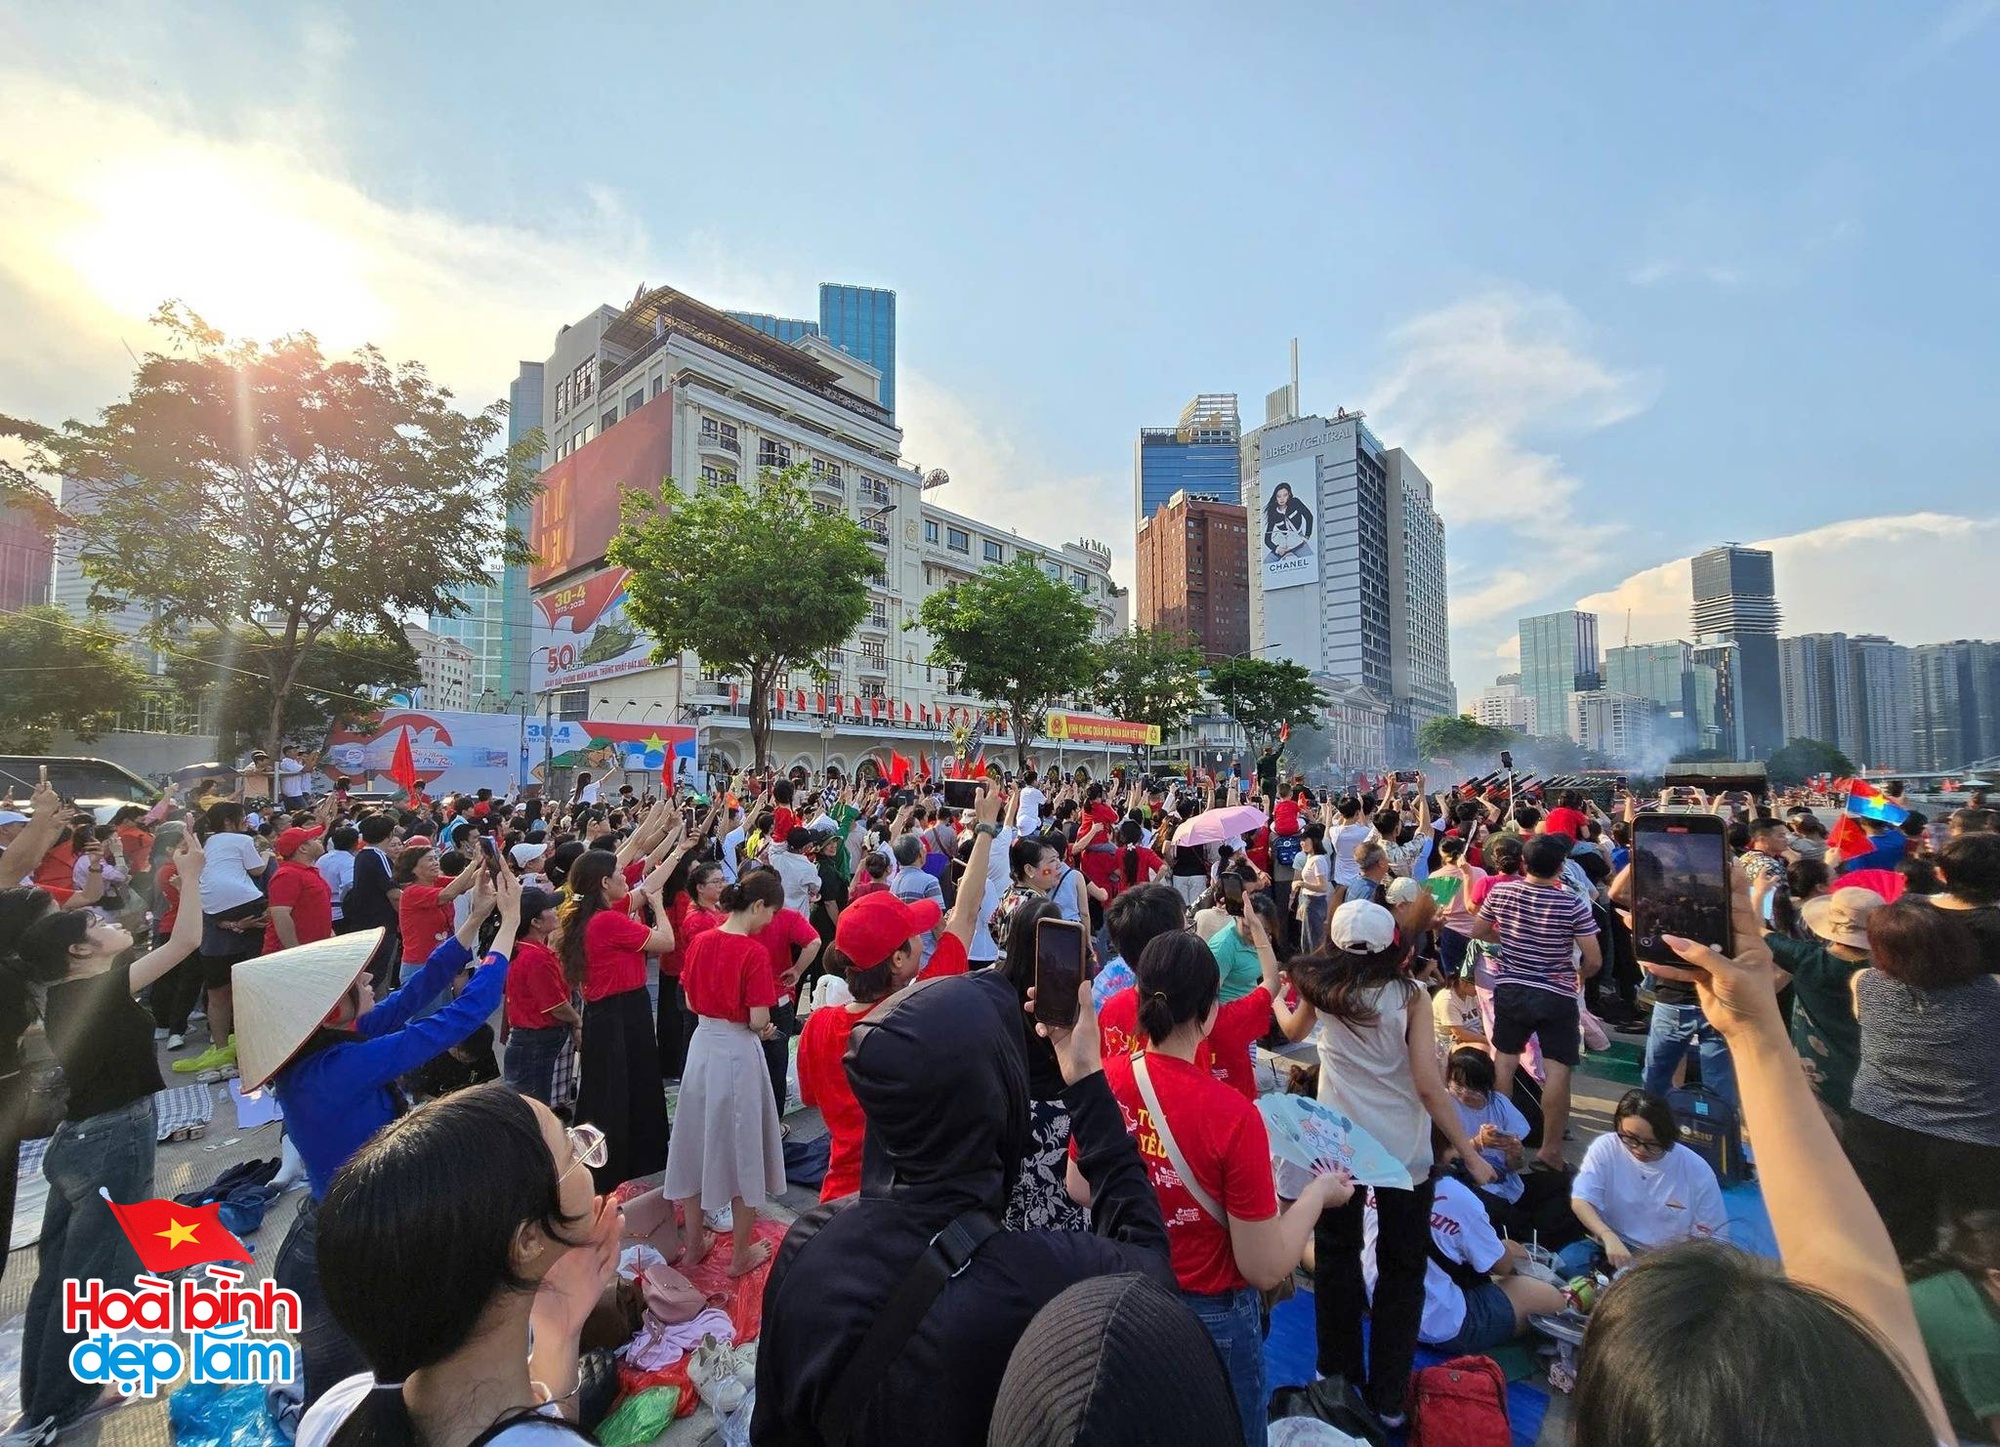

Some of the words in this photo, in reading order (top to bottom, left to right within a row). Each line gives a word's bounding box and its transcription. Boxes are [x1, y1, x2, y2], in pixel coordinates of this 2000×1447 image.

[1264, 438, 1304, 459] LIBERTY
[1303, 427, 1352, 449] CENTRAL
[1269, 558, 1309, 572] CHANEL
[554, 584, 586, 608] 30-4
[547, 643, 575, 674] 50
